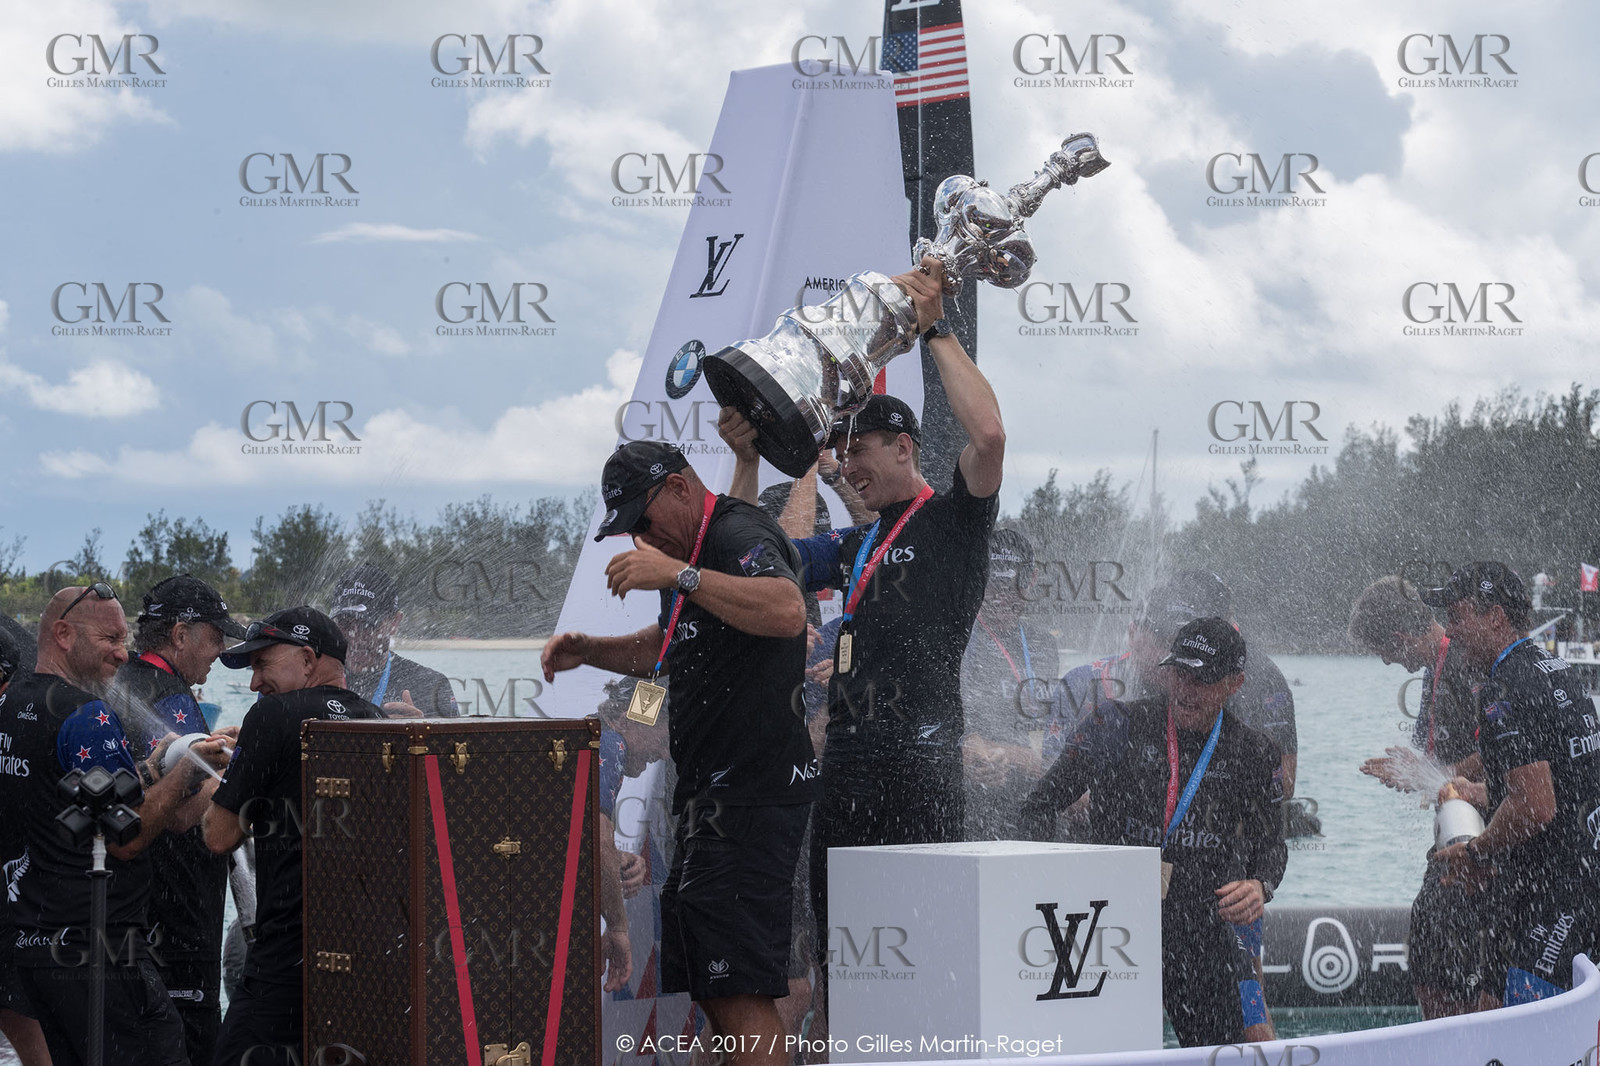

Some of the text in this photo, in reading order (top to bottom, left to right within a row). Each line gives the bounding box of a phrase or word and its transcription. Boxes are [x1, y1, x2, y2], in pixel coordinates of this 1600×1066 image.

[804, 276, 847, 292] AMERIC
[1182, 638, 1217, 656] Emirates
[17, 711, 38, 721] OMEGA
[1535, 911, 1575, 975] Emirates
